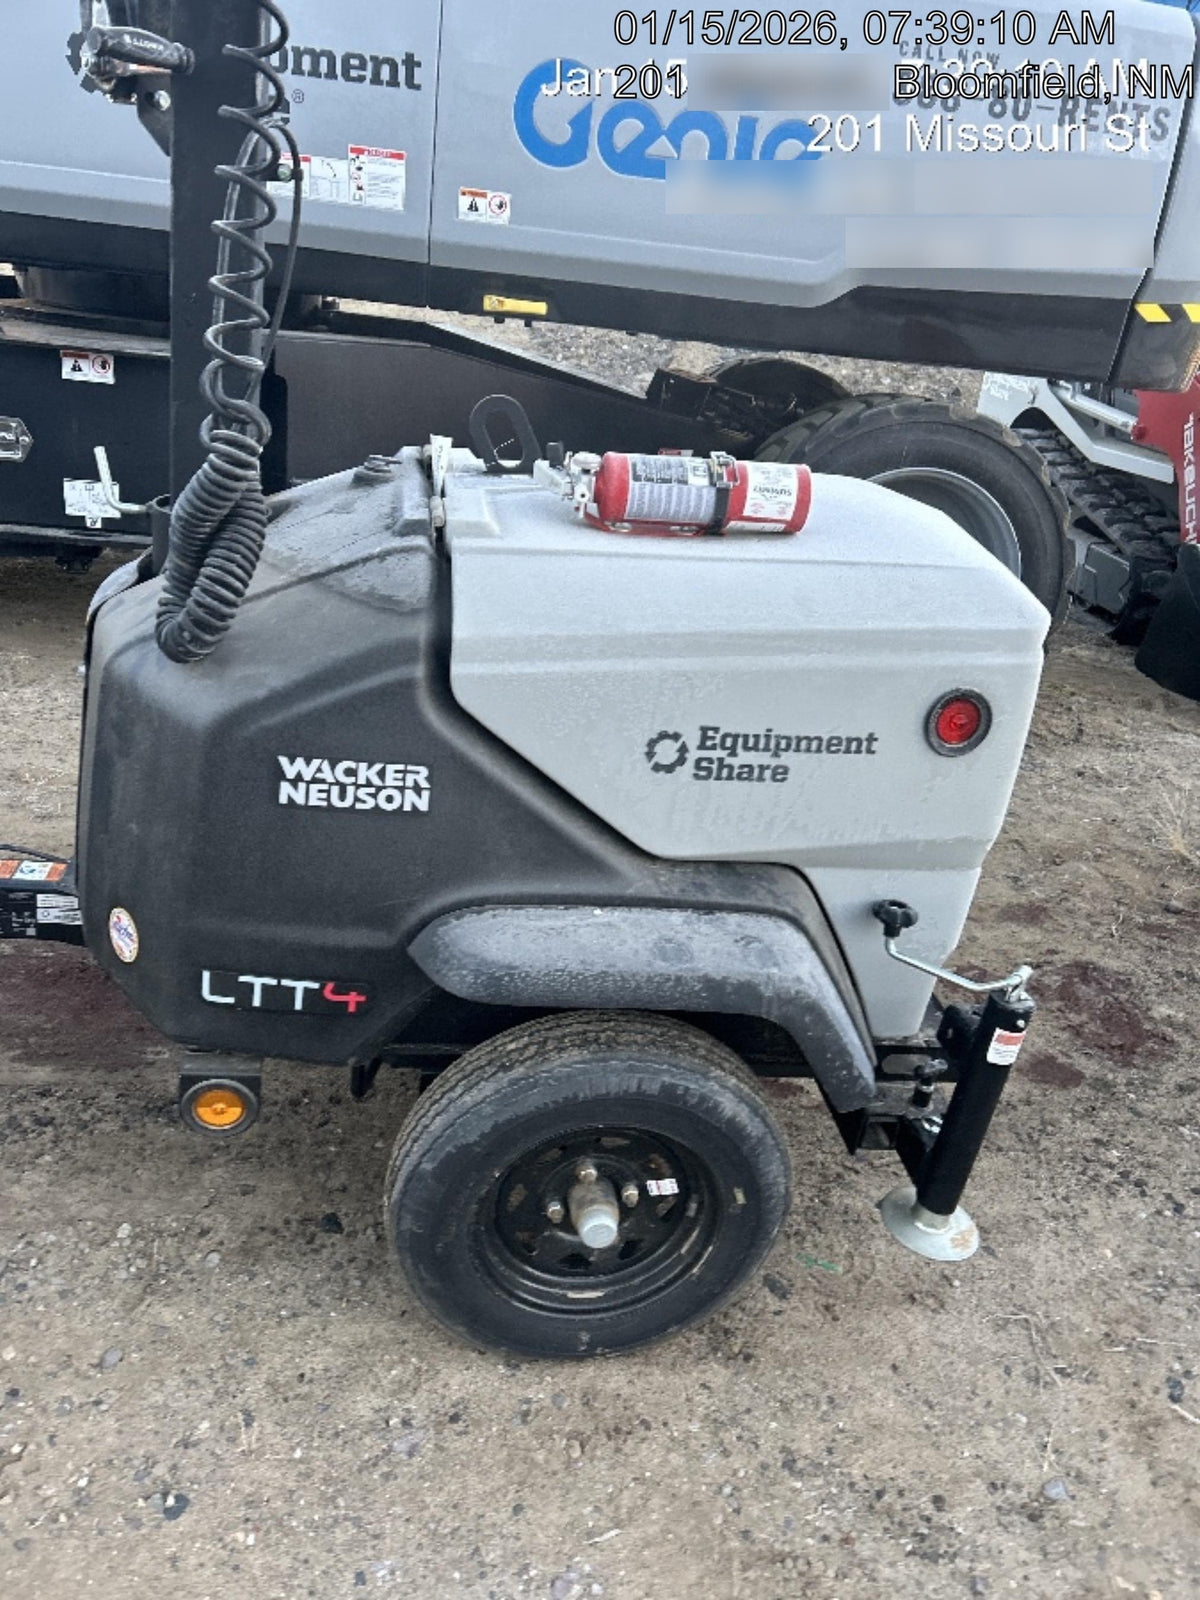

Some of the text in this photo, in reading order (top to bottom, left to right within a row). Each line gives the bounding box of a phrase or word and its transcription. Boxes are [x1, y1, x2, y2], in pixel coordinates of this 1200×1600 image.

[900, 40, 1000, 70] CALL NOW
[697, 725, 879, 758] Equipment
[277, 755, 431, 788] WACKER
[692, 756, 790, 783] Share
[278, 780, 431, 812] NEUSON
[201, 969, 367, 1013] LTT4
